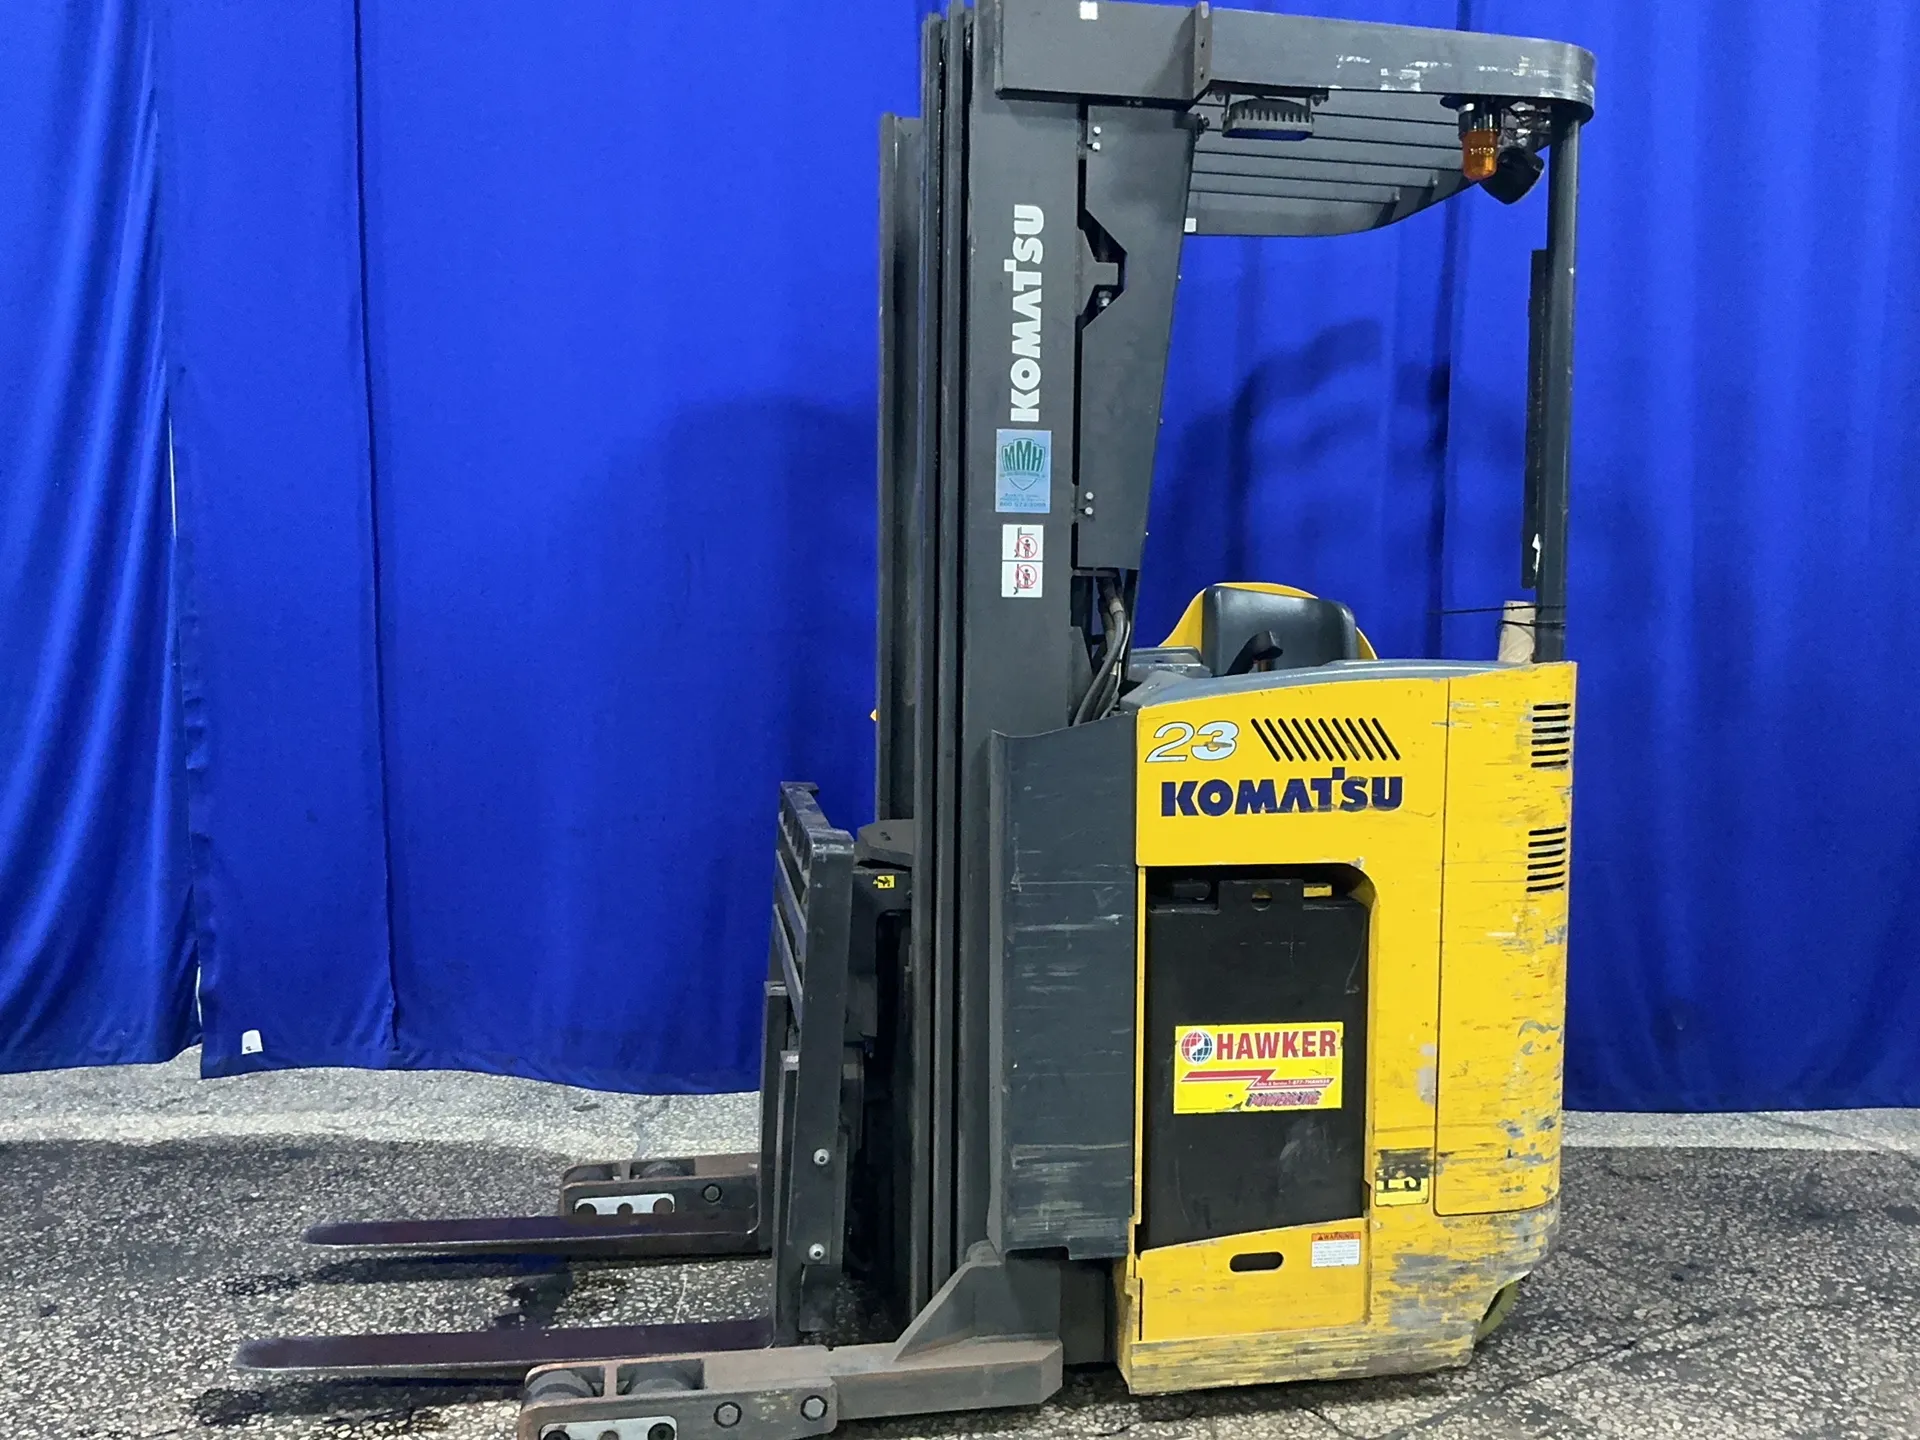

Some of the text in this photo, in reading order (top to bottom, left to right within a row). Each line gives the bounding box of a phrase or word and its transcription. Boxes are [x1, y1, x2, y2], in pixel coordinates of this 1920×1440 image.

[1003, 204, 1044, 422] KOMATSU
[1004, 440, 1043, 472] MMH
[1145, 720, 1240, 763] 23
[1161, 767, 1403, 817] KOMATSU
[1216, 1030, 1337, 1060] HAWKER
